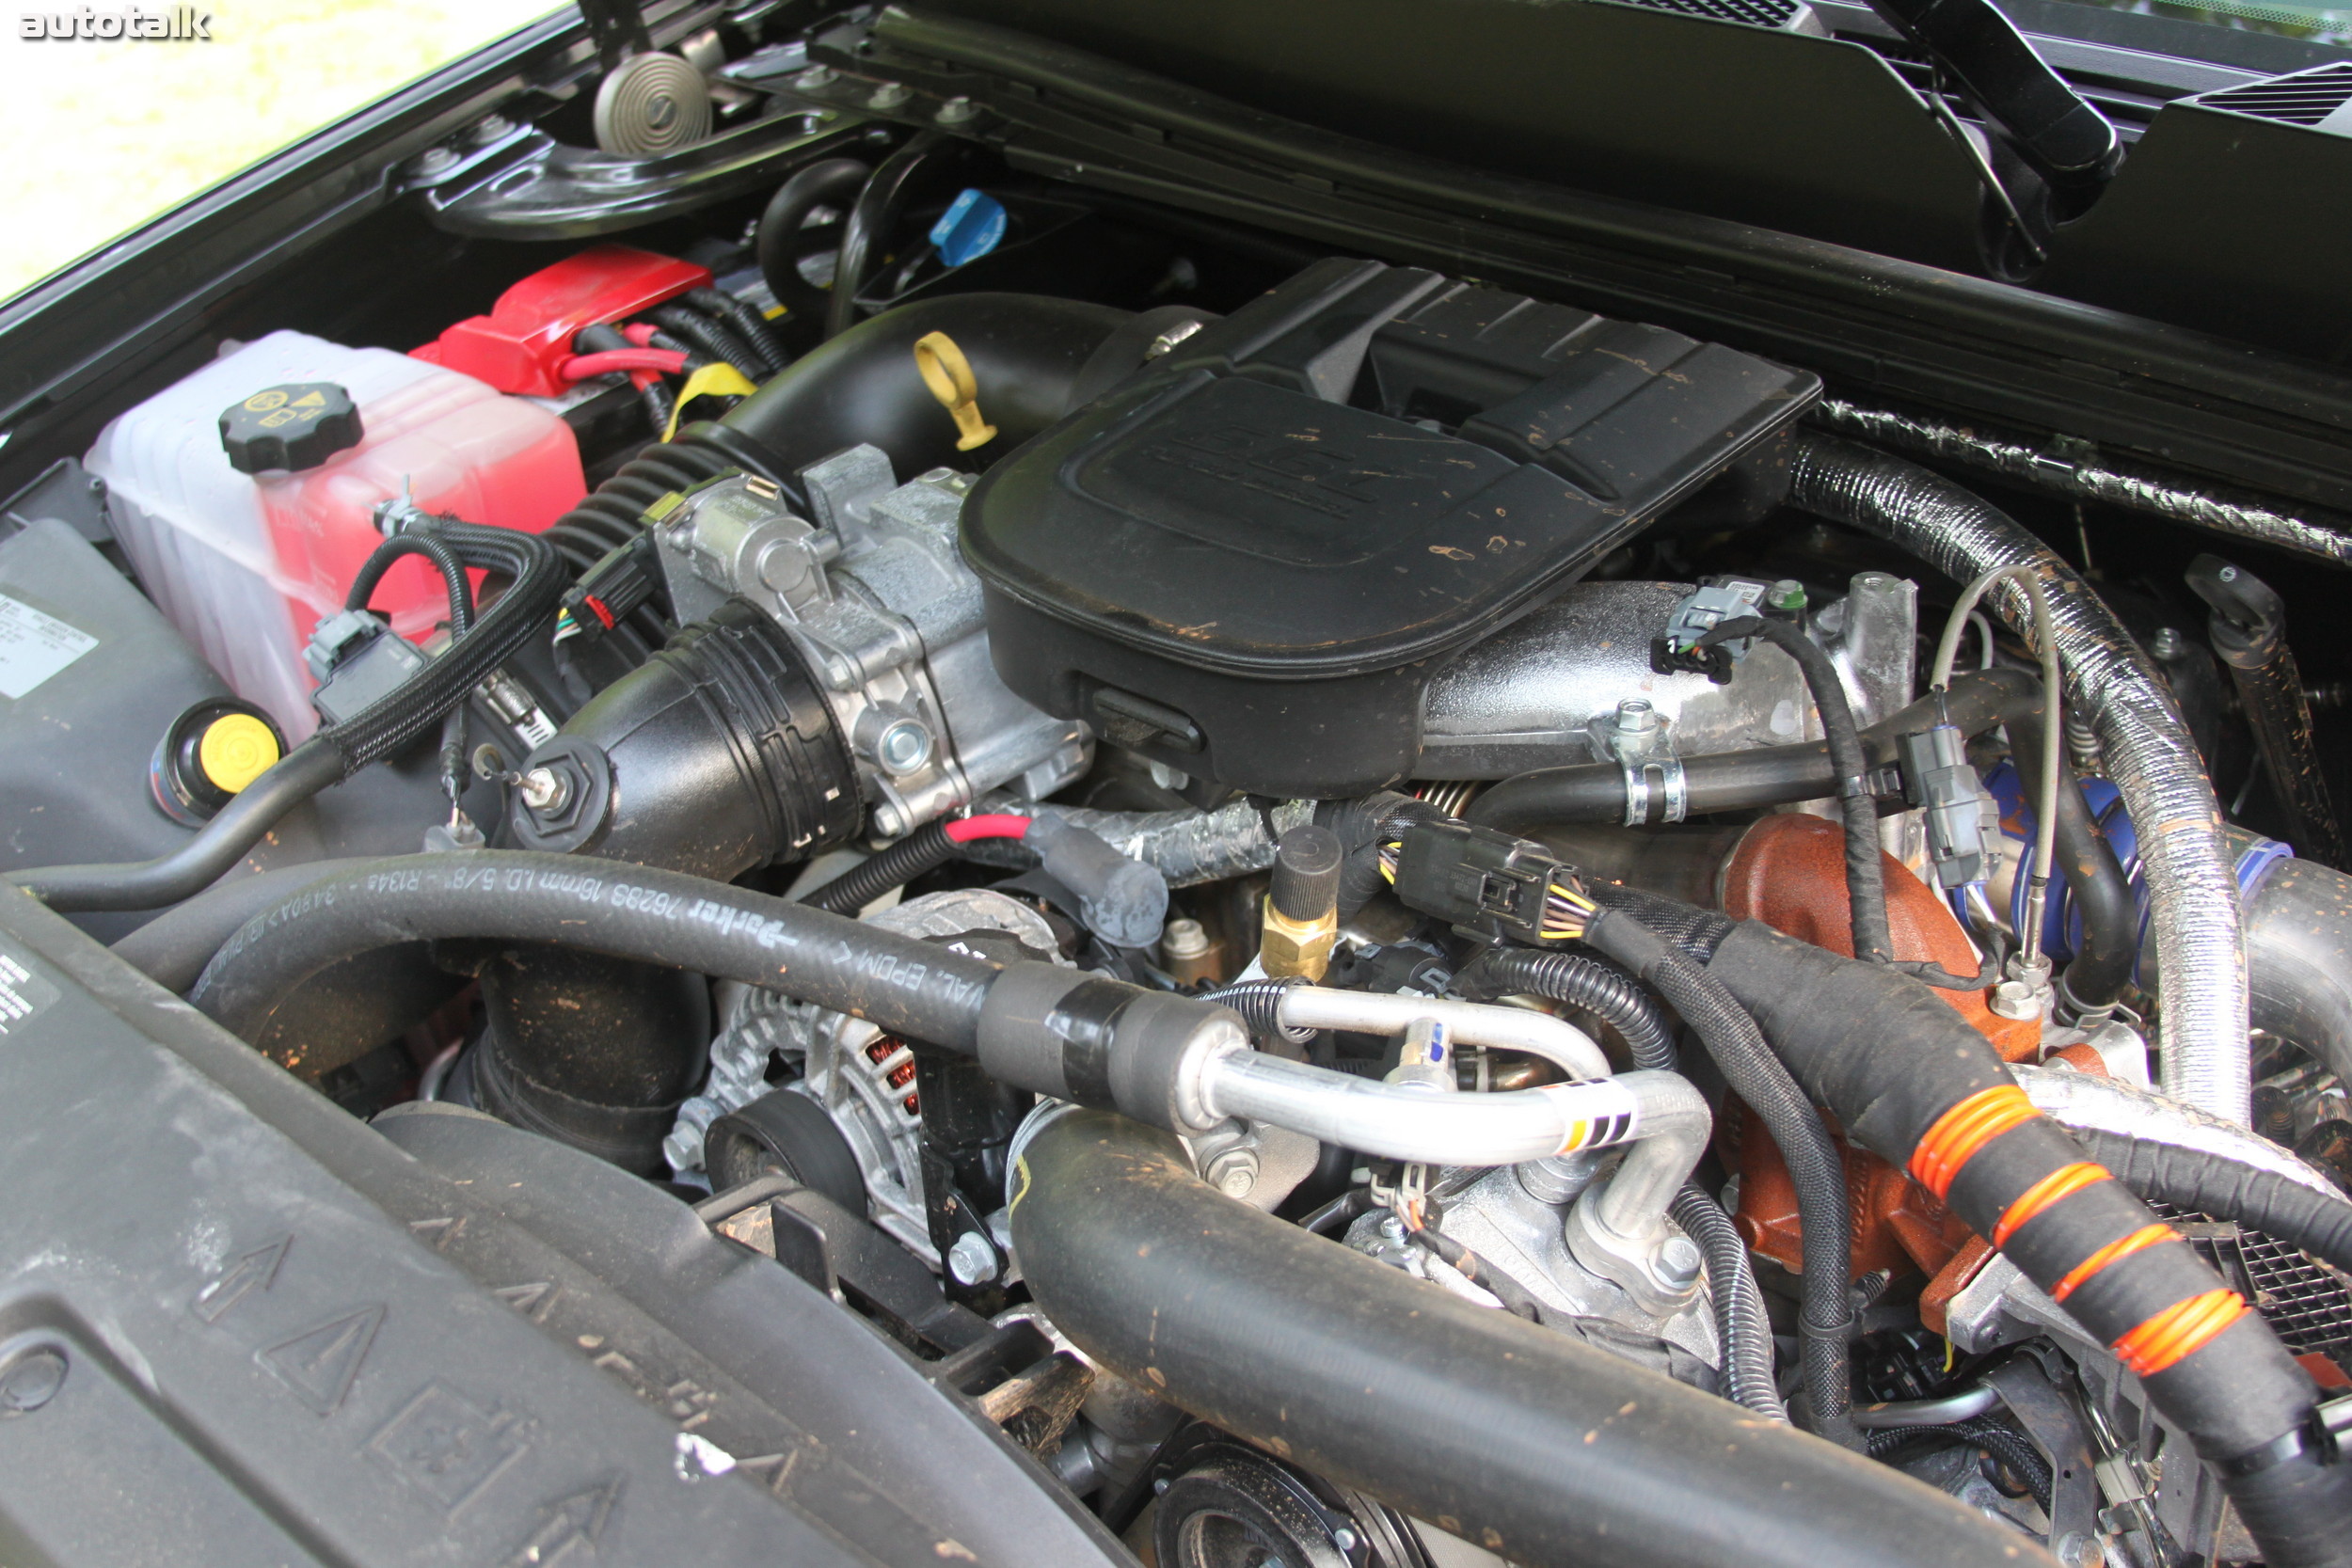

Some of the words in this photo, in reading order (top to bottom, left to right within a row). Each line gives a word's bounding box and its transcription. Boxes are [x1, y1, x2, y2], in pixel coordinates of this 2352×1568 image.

[368, 869, 422, 892] R134a
[539, 873, 603, 902] 16mm
[688, 897, 787, 949] Parker
[856, 948, 928, 991] EPDM
